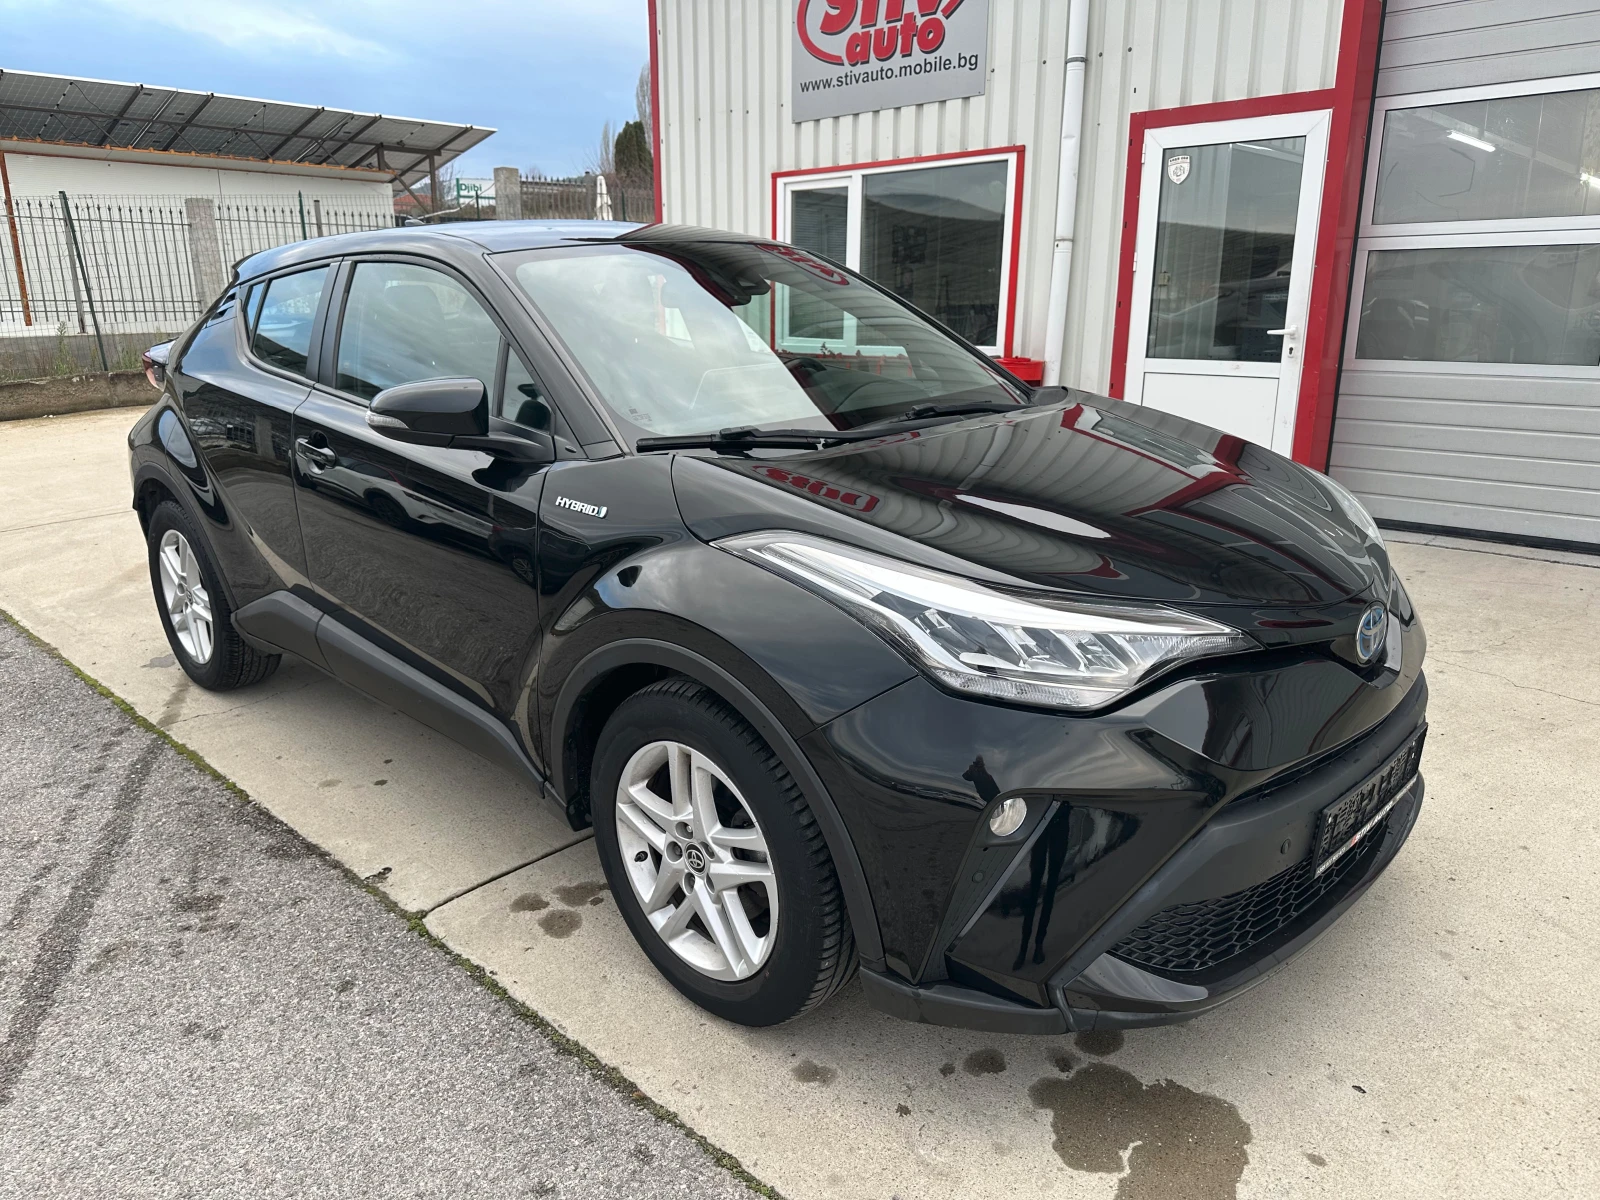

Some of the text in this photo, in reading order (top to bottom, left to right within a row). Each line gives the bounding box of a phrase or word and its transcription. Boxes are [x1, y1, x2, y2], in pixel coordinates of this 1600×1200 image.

[845, 12, 946, 66] auto
[800, 53, 979, 93] www.stivauto.mobile.bg
[460, 183, 482, 194] Djibi
[555, 496, 599, 517] HYBRID
